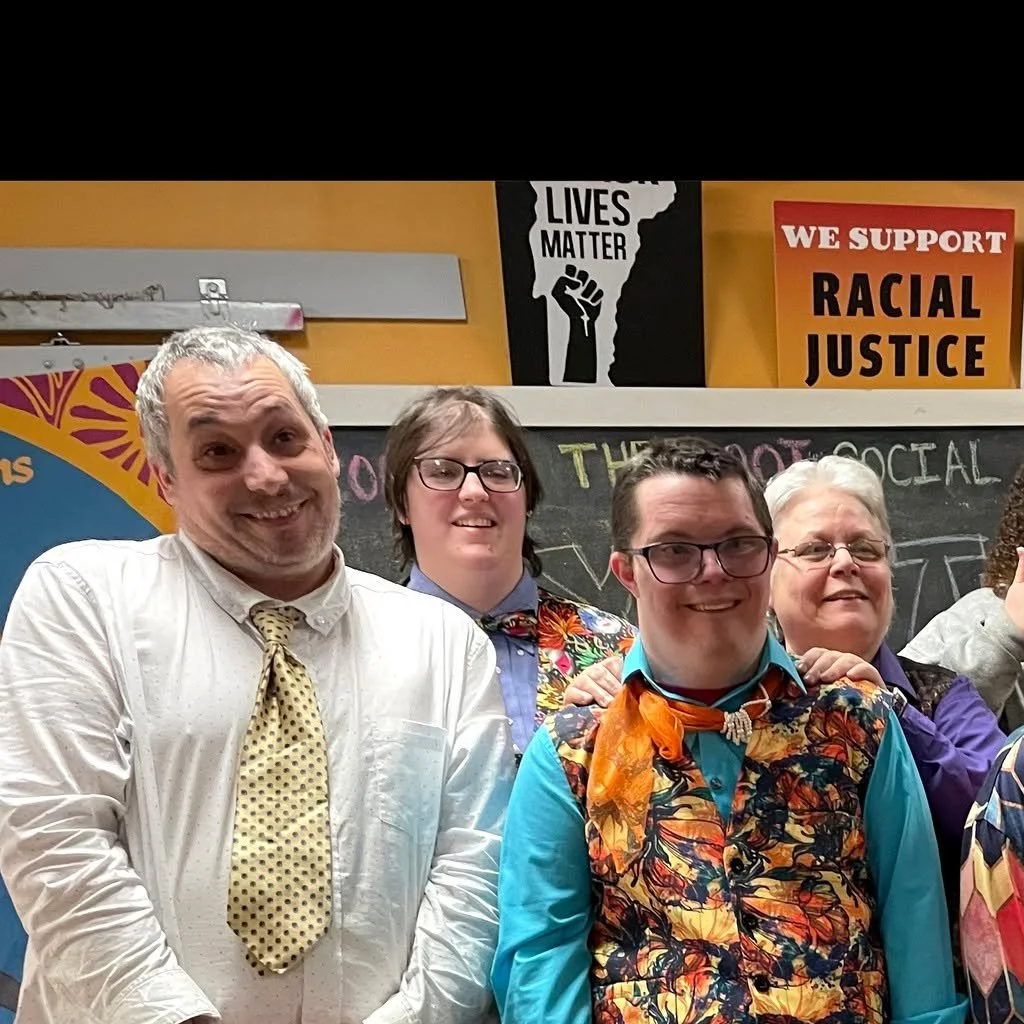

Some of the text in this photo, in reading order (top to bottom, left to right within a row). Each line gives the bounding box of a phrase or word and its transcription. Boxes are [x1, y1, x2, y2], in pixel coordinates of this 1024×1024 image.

[545, 186, 631, 226] LIVES
[540, 229, 627, 260] MATTER
[781, 225, 1007, 254] WE SUPPORT
[812, 271, 982, 319] RACIAL
[804, 333, 986, 388] JUSTICE
